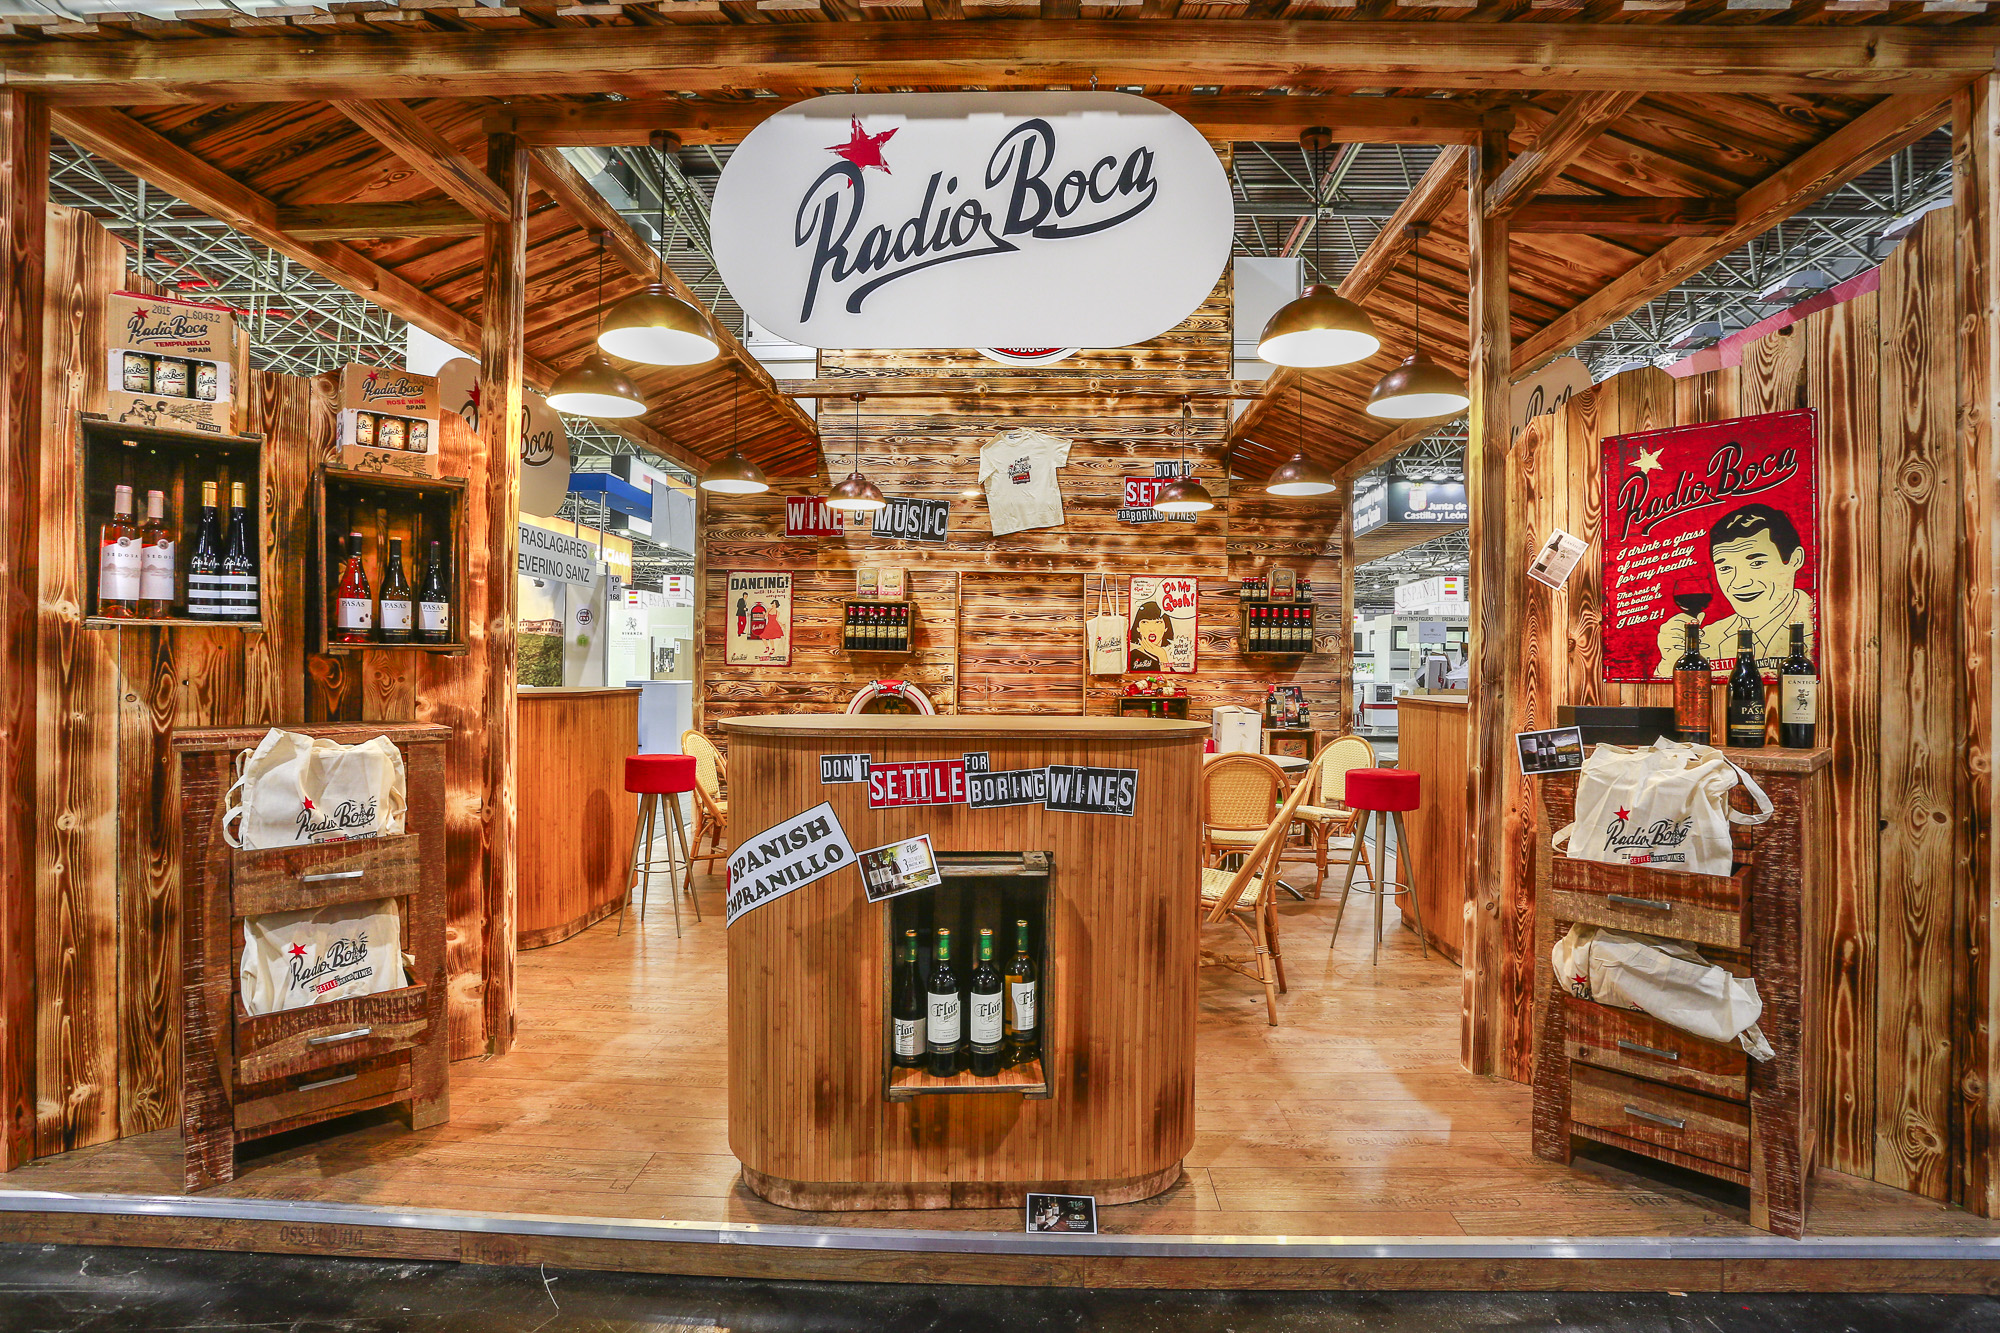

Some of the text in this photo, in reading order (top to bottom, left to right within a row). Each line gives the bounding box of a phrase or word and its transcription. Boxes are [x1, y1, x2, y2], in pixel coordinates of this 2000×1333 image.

[795, 117, 1158, 323] Radio Boca
[152, 304, 172, 316] 2015
[127, 315, 208, 345] Radio Boca
[154, 340, 210, 348] TEMPRANILLO
[362, 377, 424, 403] Radio Boca
[1156, 463, 1190, 477] DONT
[1616, 441, 1799, 542] Radio Boca
[1117, 509, 1196, 522] FOR BORING WINES
[1428, 502, 1467, 511] Junta de
[787, 501, 843, 530] WINE
[873, 503, 947, 536] MUSIC
[1404, 511, 1467, 521] Castilla y León
[1616, 528, 1707, 560] I drink a glass
[1617, 545, 1695, 574] of wine a day
[565, 564, 590, 583] SANZ
[1615, 557, 1698, 588] for my health.
[730, 576, 789, 591] DANCING!
[1162, 581, 1177, 595] Oh
[1177, 580, 1191, 593] My
[1402, 580, 1437, 603] ESPAÑA
[1616, 582, 1662, 601] The rest of
[341, 600, 365, 608] PASAS
[609, 593, 620, 601] 168
[1162, 592, 1195, 612] Gosh!
[1616, 592, 1663, 609] the bottle is
[423, 603, 444, 611] PASAS
[1616, 604, 1650, 617] because
[1616, 616, 1627, 629] I
[1627, 614, 1650, 626] like
[823, 756, 1135, 807] DON'T SETTLE FOR BORING WINES
[295, 808, 344, 841] Radio
[1603, 818, 1654, 853] Radio
[732, 815, 833, 884] SPANISH
[1630, 854, 1651, 864] SETTLE
[1667, 853, 1685, 862] WINES
[316, 979, 339, 994] SETTLE
[931, 1000, 959, 1018] Flor
[895, 1023, 915, 1037] Flor
[279, 1225, 322, 1244] rosso
